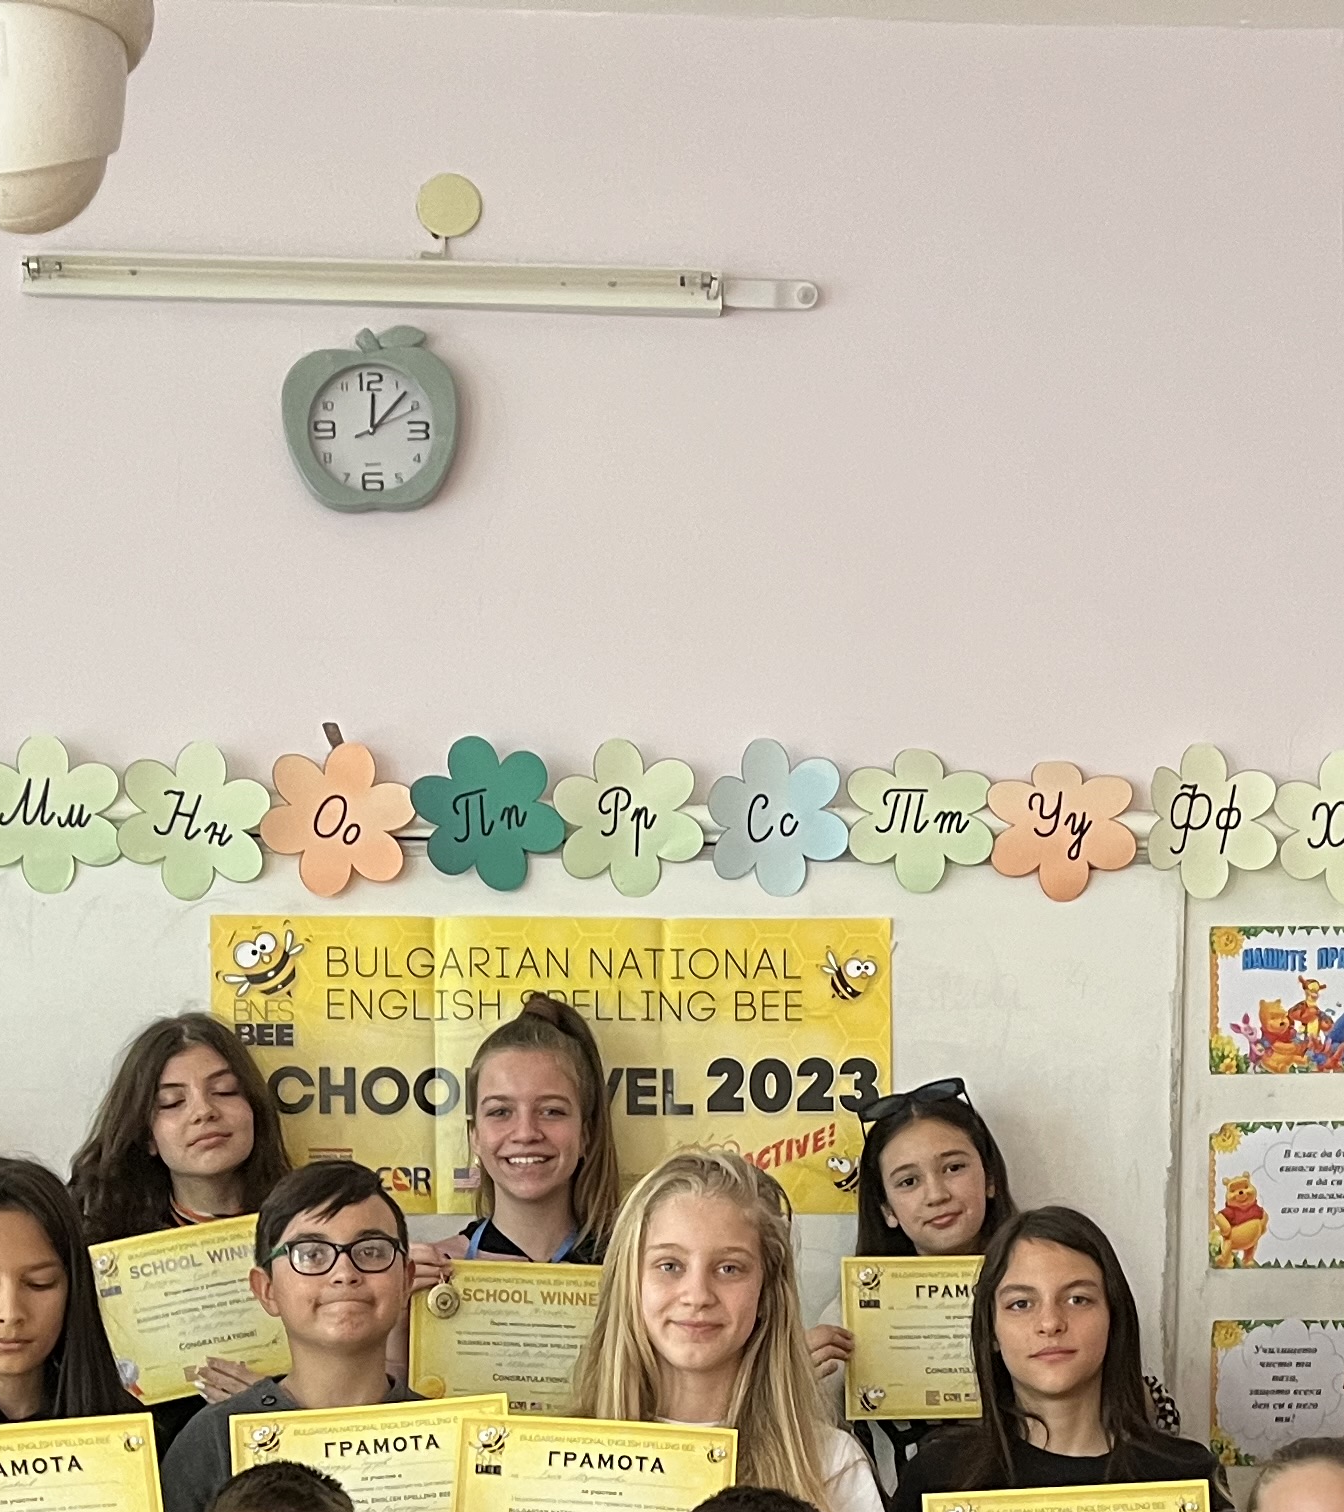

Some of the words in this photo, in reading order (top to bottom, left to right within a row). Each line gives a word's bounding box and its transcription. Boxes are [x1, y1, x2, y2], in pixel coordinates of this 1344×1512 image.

[341, 382, 348, 391] 11
[357, 372, 383, 391] 12
[322, 401, 334, 411] 10
[313, 420, 336, 439] 9
[407, 421, 430, 441] 3
[413, 453, 421, 463] 4
[343, 473, 350, 483] 7
[362, 472, 384, 491] 6
[395, 473, 403, 483] 5
[326, 946, 570, 980] BULGARIAN
[590, 946, 802, 980] NATIONAL
[1242, 948, 1307, 972] НАШИТЕ
[233, 999, 294, 1022] BNES
[326, 989, 501, 1020] ENGLISH
[735, 990, 803, 1022] BEE
[235, 1024, 294, 1046] BEE
[268, 1066, 474, 1116] CHOO
[607, 1067, 694, 1115] VEL
[706, 1057, 879, 1113] 2023
[130, 1254, 201, 1279] SCHOOL
[207, 1244, 256, 1263] WINN
[462, 1288, 533, 1305] SCHOOL
[540, 1291, 598, 1307] WINNE
[916, 1284, 969, 1298] ГРАМ
[324, 1433, 440, 1457] ГРАМОТА
[548, 1451, 665, 1473] ГРАМОТА
